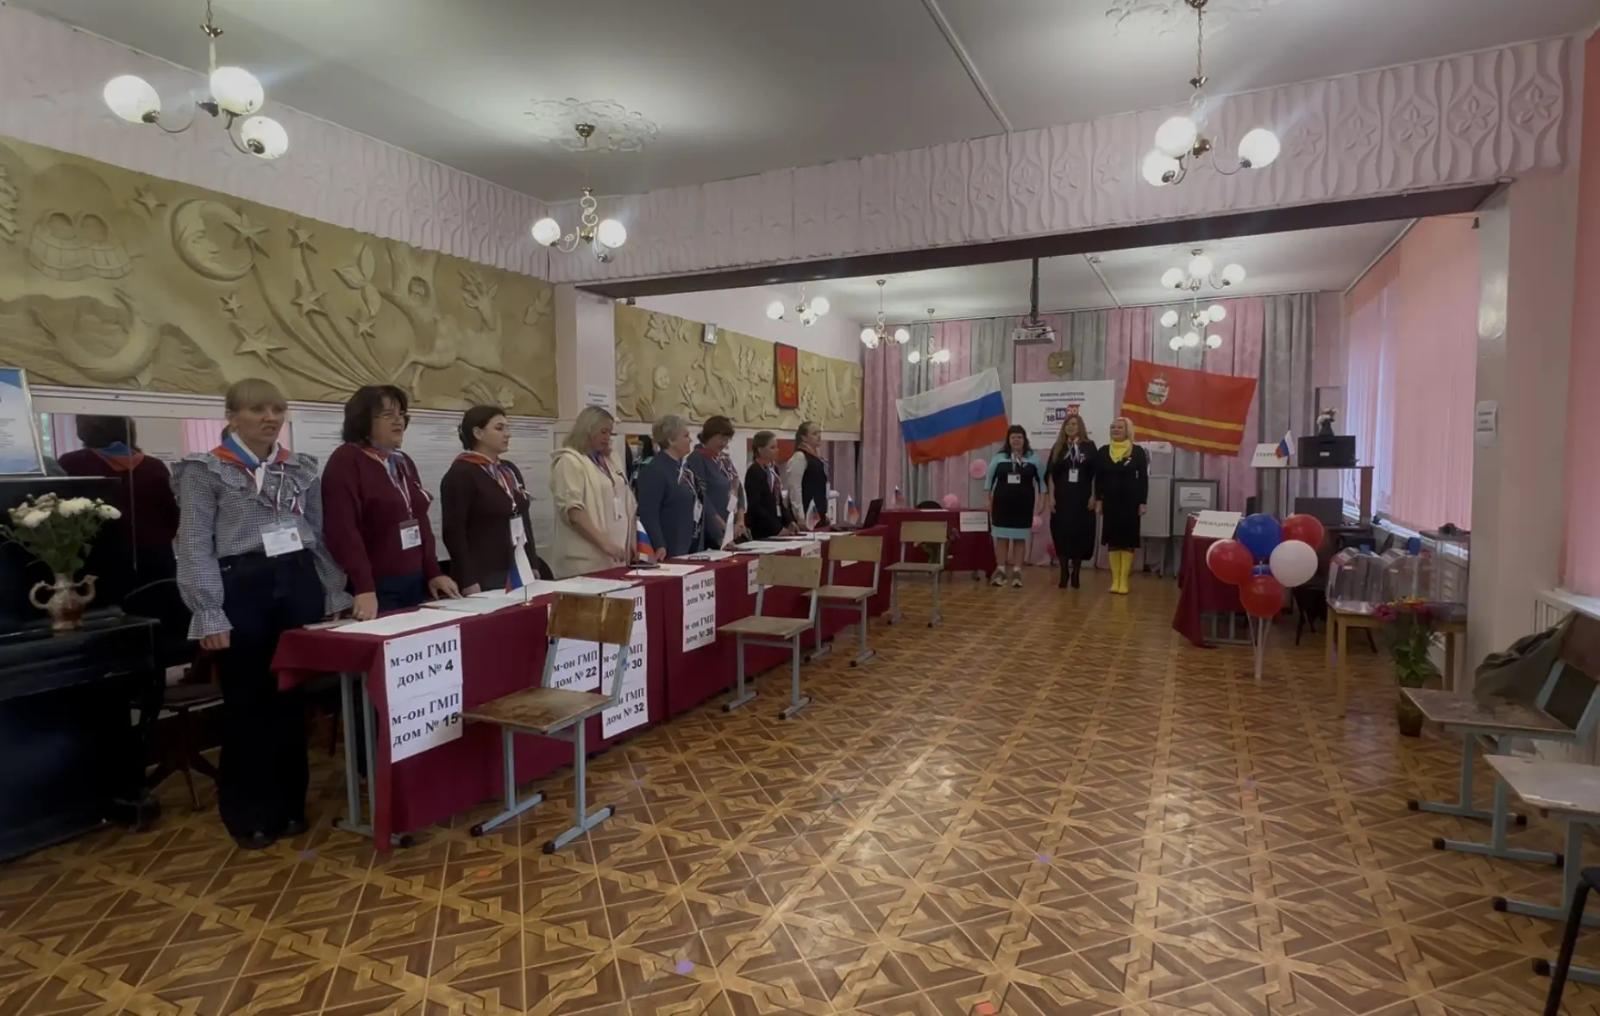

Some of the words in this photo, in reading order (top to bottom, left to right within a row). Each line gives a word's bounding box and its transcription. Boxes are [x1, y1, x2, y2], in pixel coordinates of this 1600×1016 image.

[633, 611, 643, 621] 28
[390, 651, 423, 668] м-он
[427, 638, 458, 658] ГМП
[553, 658, 576, 672] м-он
[577, 650, 598, 666] ГМП
[602, 653, 618, 663] м-о
[628, 643, 643, 655] МП
[396, 670, 424, 689] дом
[428, 663, 442, 678] №
[444, 659, 454, 672] 4
[574, 670, 585, 681] №
[585, 666, 597, 678] 22
[603, 668, 616, 680] до
[632, 658, 643, 670] 30
[625, 687, 645, 703] ГМП
[391, 707, 425, 726] м-он
[429, 693, 459, 715] ГМП
[606, 713, 622, 726] дом
[623, 706, 633, 718] №
[634, 702, 644, 714] 32
[392, 728, 421, 748] дом
[425, 720, 439, 735] №
[442, 711, 459, 728] 15
